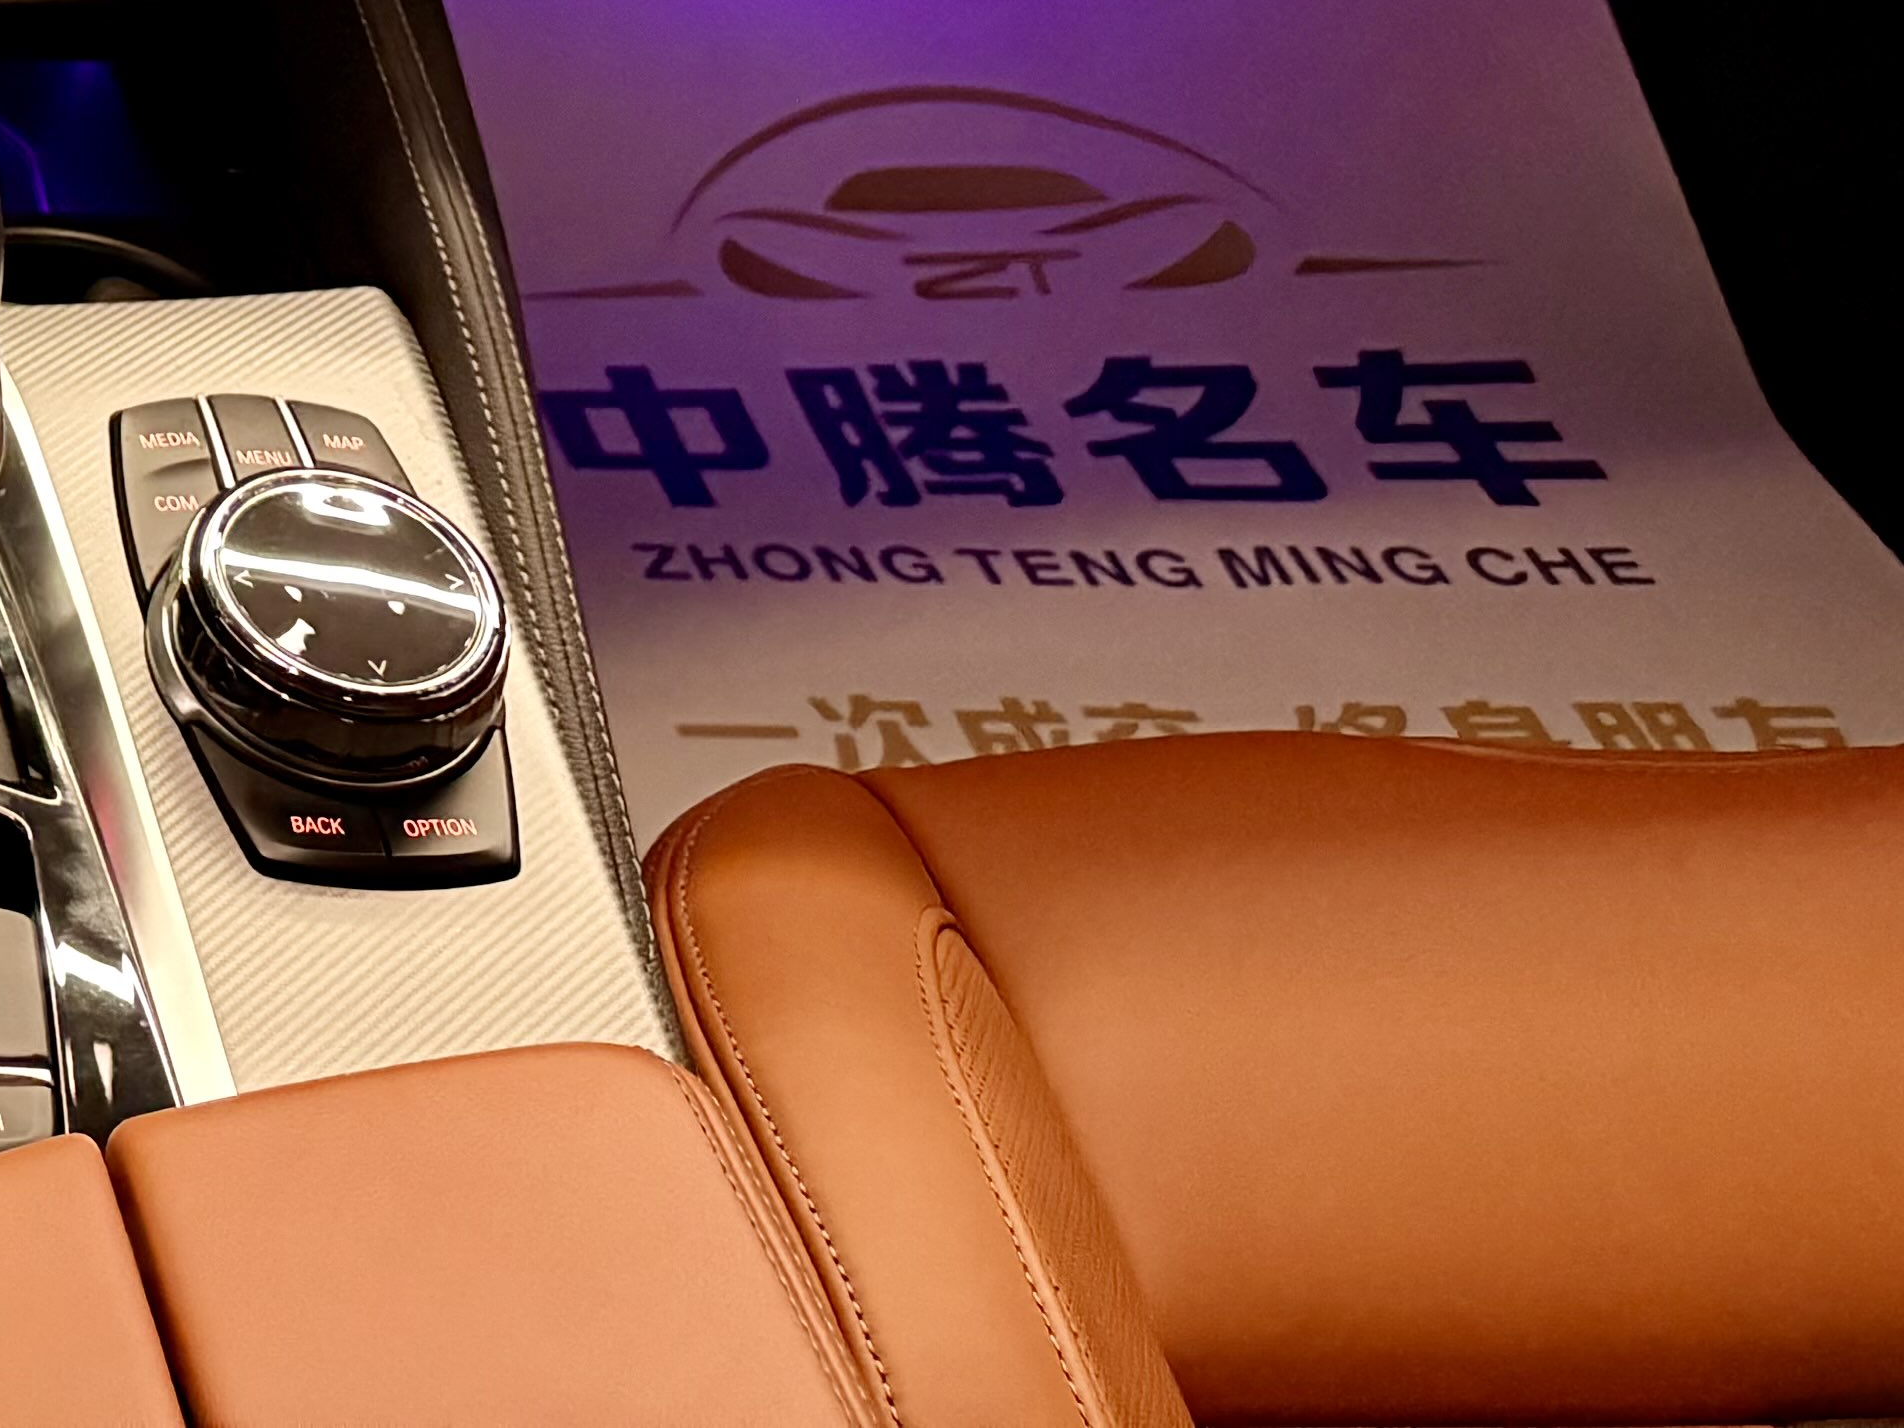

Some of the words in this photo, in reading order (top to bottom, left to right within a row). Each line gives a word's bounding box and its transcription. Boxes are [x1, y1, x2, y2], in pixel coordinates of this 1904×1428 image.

[538, 348, 1609, 508] 中腾名车
[139, 431, 201, 450] MEDIA
[324, 434, 366, 452] MAP
[236, 449, 292, 466] MENU
[154, 495, 200, 513] COM
[632, 542, 945, 585] ZHONG
[955, 545, 1202, 590] TENG
[1216, 545, 1450, 590] MING
[1470, 546, 1657, 588] CHE
[290, 815, 346, 836] BACK
[403, 818, 478, 838] OPTION
